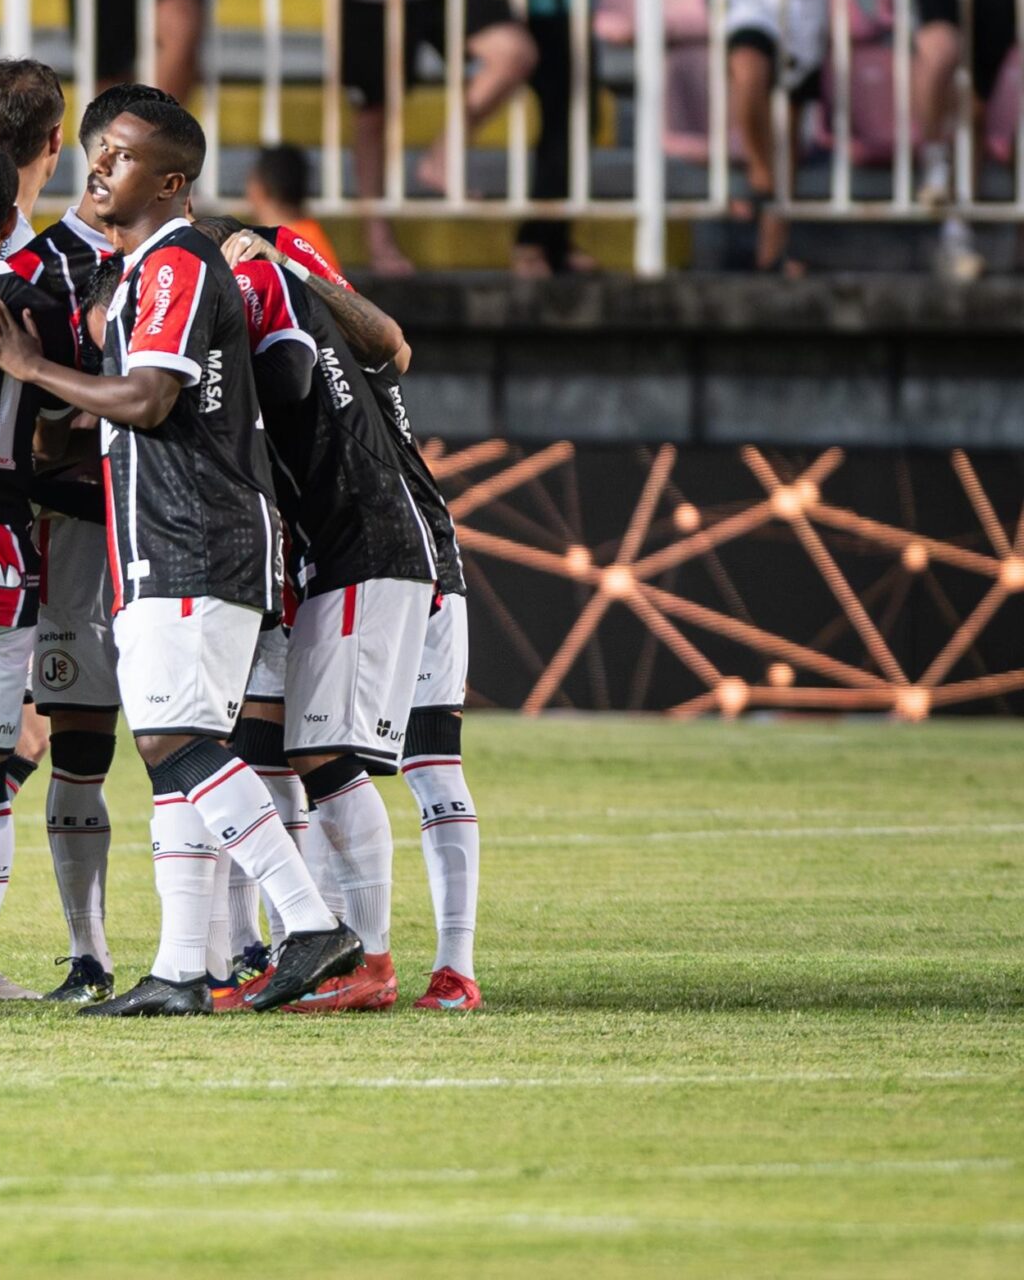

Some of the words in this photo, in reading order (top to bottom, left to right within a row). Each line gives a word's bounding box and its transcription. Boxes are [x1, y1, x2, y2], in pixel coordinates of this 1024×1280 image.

[205, 349, 222, 413] MASA
[320, 347, 353, 408] MASA
[146, 694, 171, 703] VOLT
[304, 713, 329, 723] VOLT
[422, 800, 467, 820] JEC
[47, 815, 99, 826] JEC
